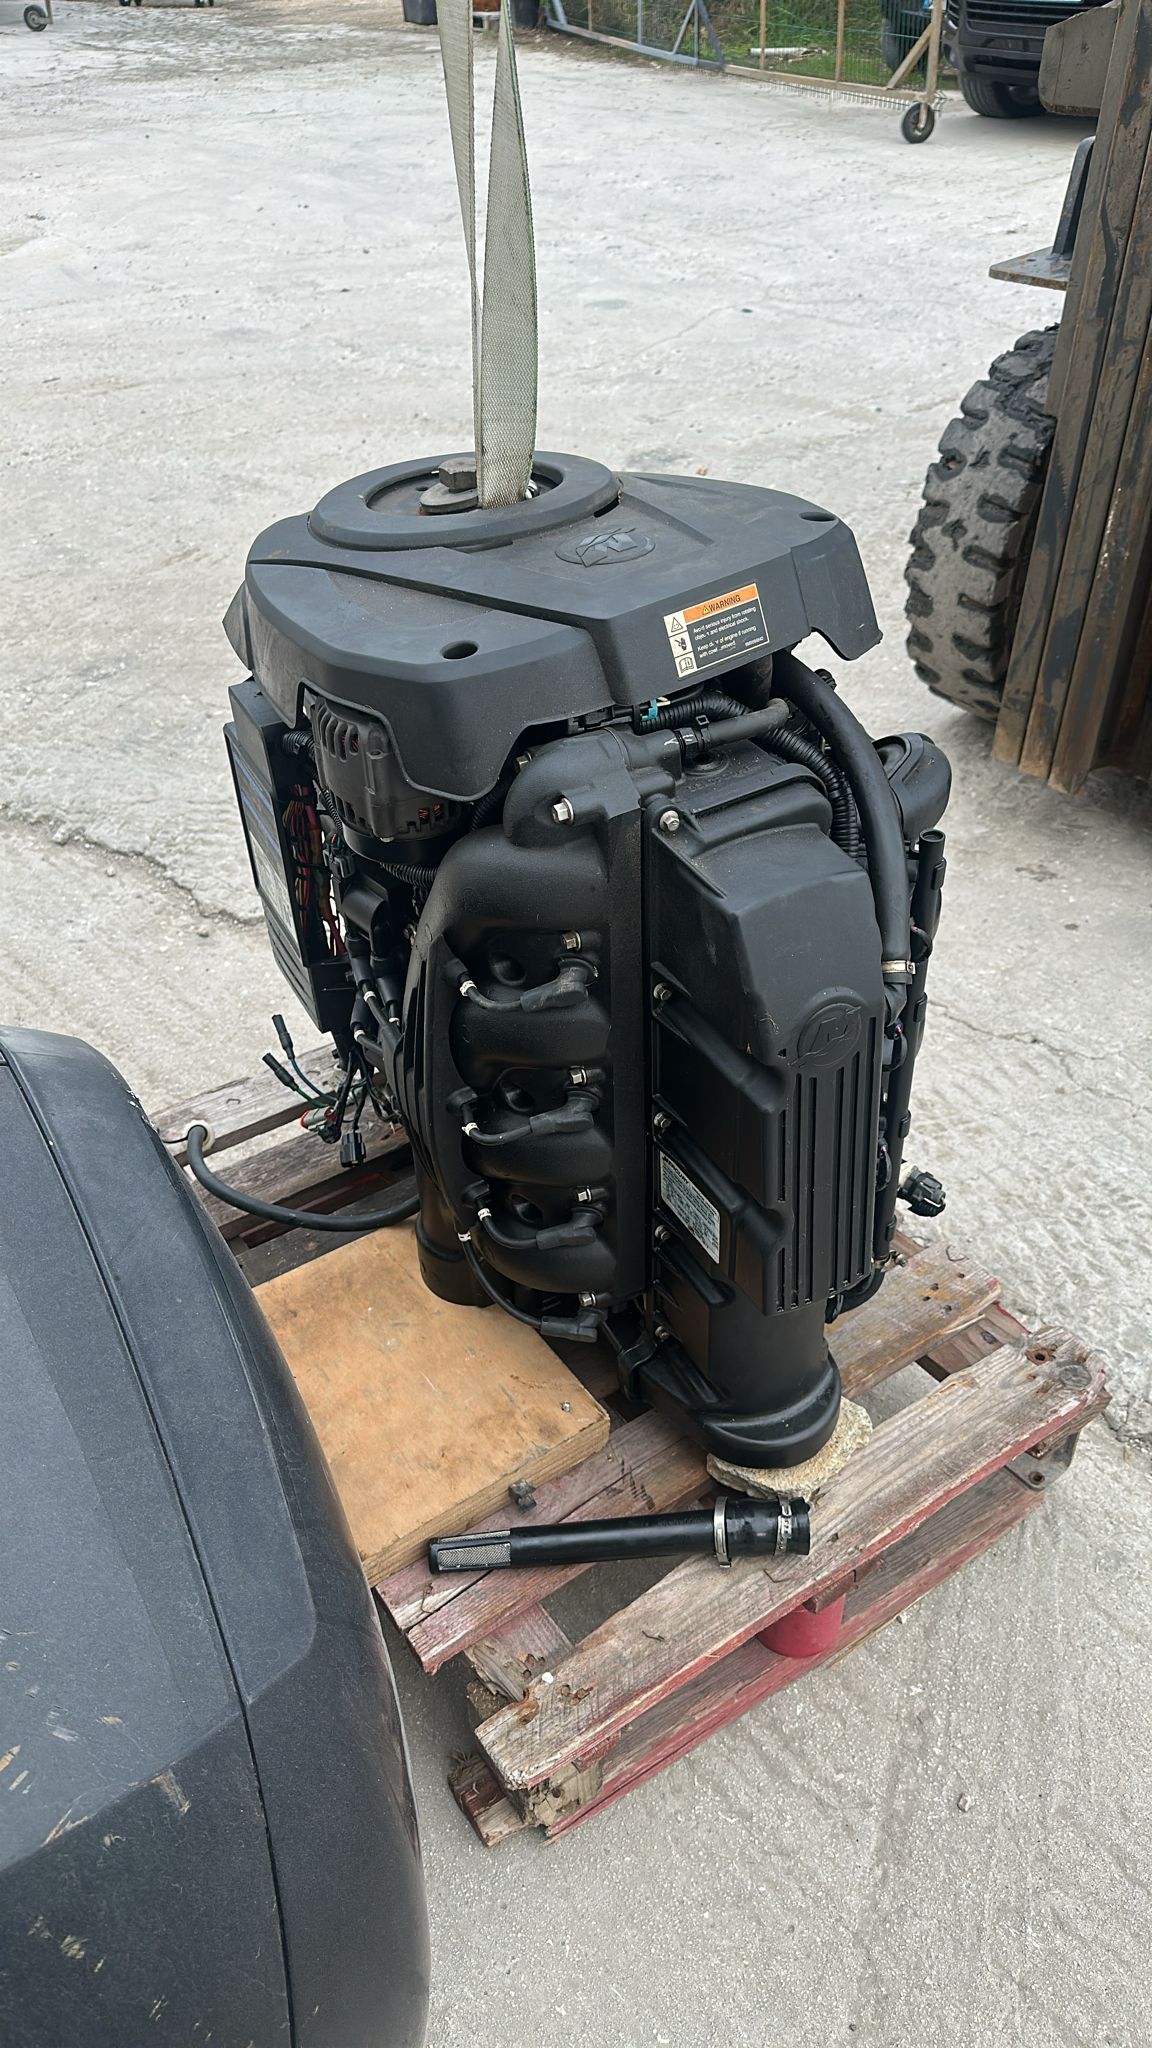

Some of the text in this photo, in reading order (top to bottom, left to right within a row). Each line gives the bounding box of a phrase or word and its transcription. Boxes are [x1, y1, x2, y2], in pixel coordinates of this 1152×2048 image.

[708, 594, 741, 612] WARNING
[705, 620, 721, 629] serious
[721, 615, 731, 624] injury
[731, 611, 741, 619] from
[697, 643, 708, 652] Keep
[724, 632, 738, 642] engine
[741, 625, 757, 635] running
